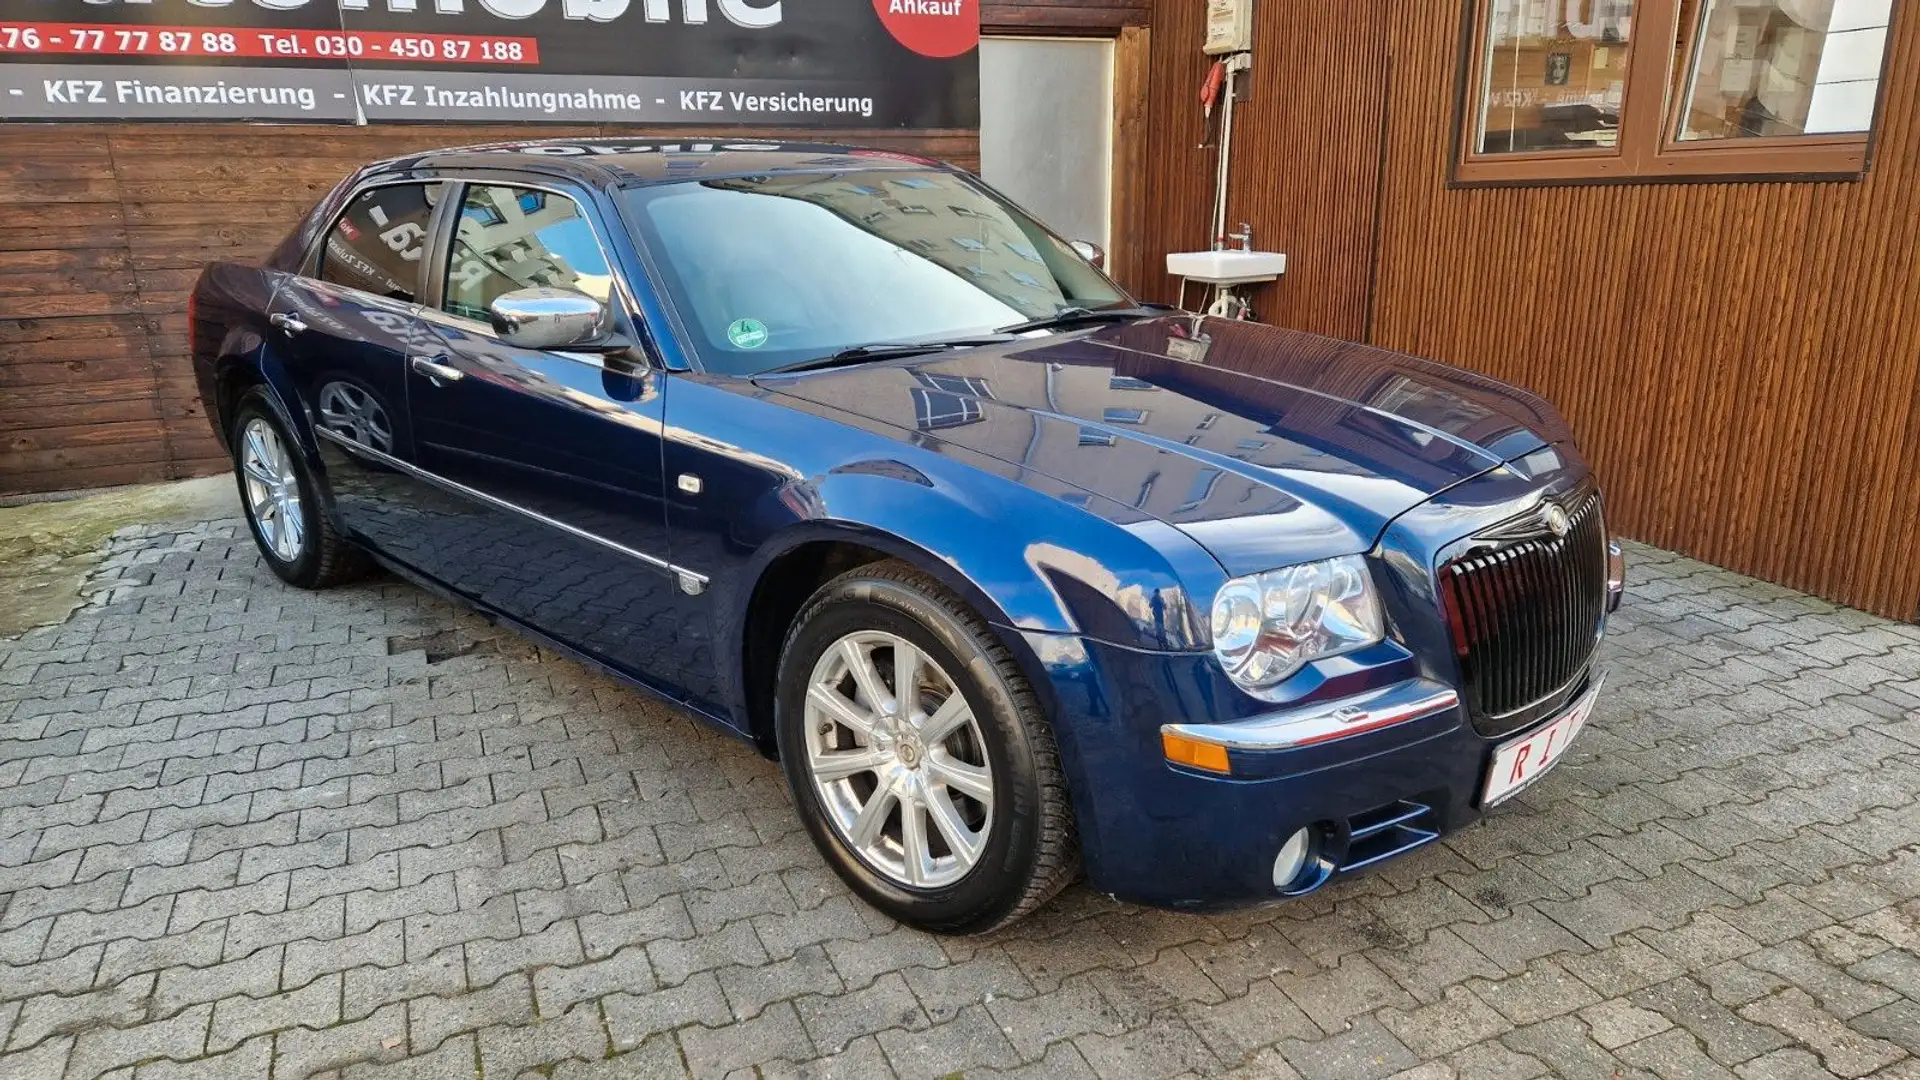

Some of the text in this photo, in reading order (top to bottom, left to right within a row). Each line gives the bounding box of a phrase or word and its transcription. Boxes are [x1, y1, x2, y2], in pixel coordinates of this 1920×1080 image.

[888, 0, 962, 16] Ankauf
[70, 29, 104, 50] 77
[115, 31, 148, 50] 77
[159, 31, 192, 52] 87
[202, 32, 237, 53] 88
[258, 34, 307, 54] Tel.
[314, 36, 363, 55] 030
[389, 39, 435, 58] 450
[443, 41, 470, 59] 87
[480, 41, 523, 60] 188
[44, 80, 106, 103] KFZ
[115, 80, 315, 110] Finanzierung
[362, 84, 416, 106] KFZ
[423, 85, 641, 113] Inzahlungnahme
[680, 91, 723, 111] KFZ
[728, 92, 873, 117] Versicherung
